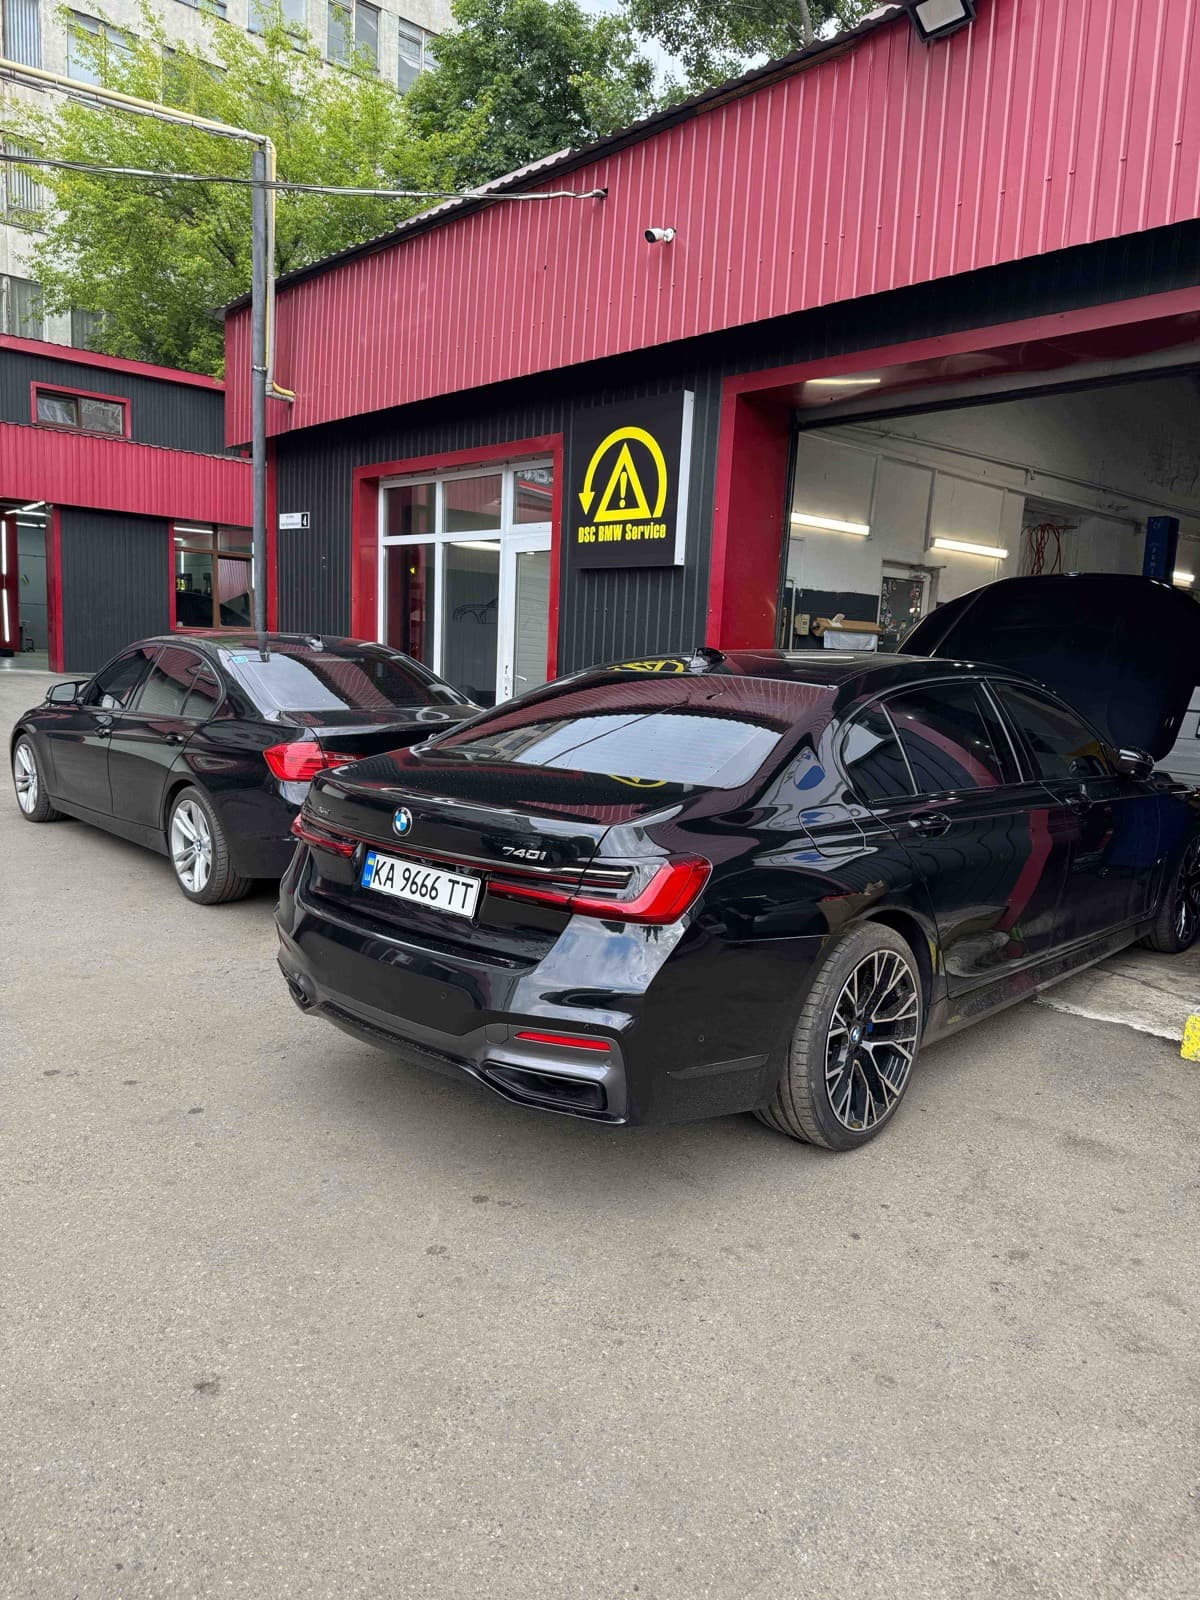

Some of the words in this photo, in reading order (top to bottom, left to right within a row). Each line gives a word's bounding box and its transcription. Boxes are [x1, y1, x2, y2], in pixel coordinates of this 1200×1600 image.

[577, 526, 596, 543] DSC
[598, 524, 623, 542] BMW
[625, 522, 667, 541] Service
[502, 846, 547, 860] 740i
[372, 859, 395, 889] KA
[400, 867, 442, 901] 9666
[448, 878, 474, 910] TT
